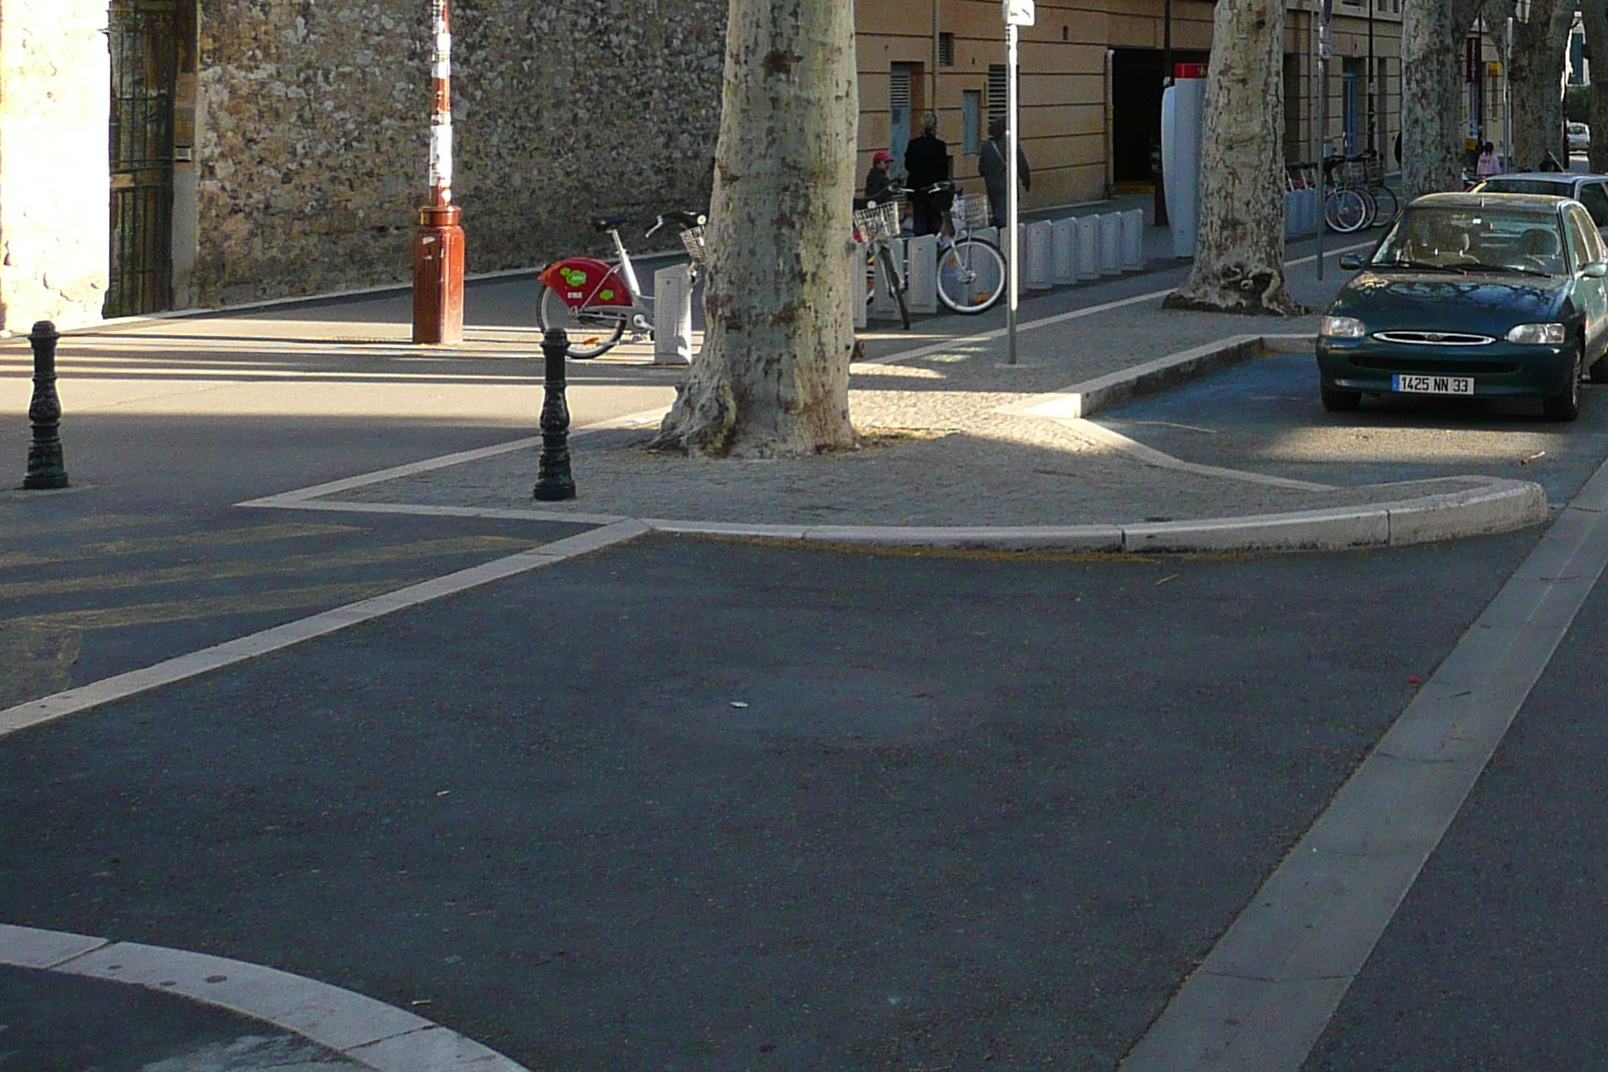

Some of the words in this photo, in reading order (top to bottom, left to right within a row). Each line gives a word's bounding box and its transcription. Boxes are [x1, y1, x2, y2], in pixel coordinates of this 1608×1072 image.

[1401, 376, 1429, 391] 1425
[1433, 378, 1449, 391] NN
[1453, 379, 1468, 392] 33
